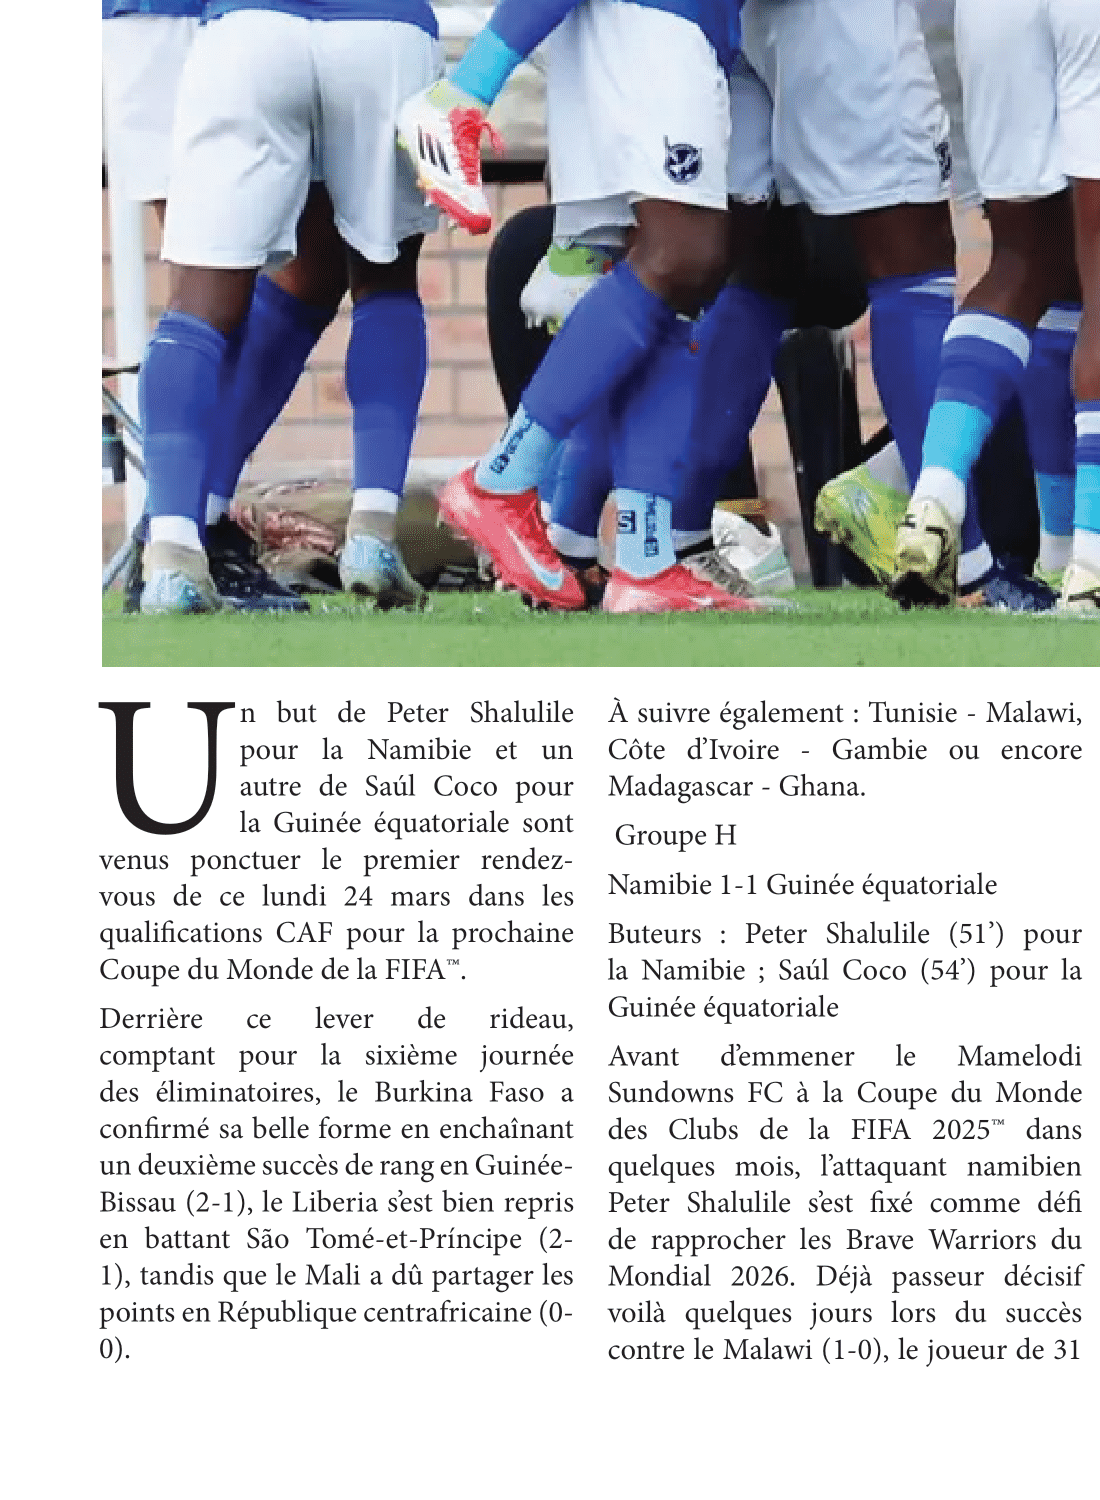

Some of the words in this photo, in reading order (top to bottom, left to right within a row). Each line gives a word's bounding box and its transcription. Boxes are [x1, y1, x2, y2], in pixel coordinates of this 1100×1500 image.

[276, 699, 317, 723] but
[337, 699, 366, 723] de
[387, 701, 449, 723] Peter
[470, 699, 574, 723] Shalulile
[239, 810, 262, 833] la
[273, 810, 362, 833] Guinée
[374, 809, 510, 840] équatoriale
[522, 814, 574, 833] sont
[615, 823, 707, 853] Groupe
[714, 824, 737, 846] H
[607, 871, 712, 895] Namibie
[721, 874, 757, 895] 1-1
[766, 872, 855, 895] Guinée
[862, 872, 998, 902] équatoriale
[99, 919, 263, 950] qualifications
[276, 921, 333, 943] CAF
[346, 927, 405, 950] pour
[417, 920, 440, 943] la
[451, 919, 574, 950] prochaine
[99, 1046, 216, 1073] comptant
[238, 1050, 298, 1073] pour
[320, 1042, 342, 1066] la
[365, 1043, 458, 1066] sixième
[479, 1043, 574, 1073] journée
[607, 1044, 680, 1067] Avant
[895, 1043, 916, 1067] le
[957, 1043, 1082, 1067] Mamelodi
[99, 1115, 210, 1139] confirmé
[219, 1123, 244, 1139] sa
[251, 1115, 310, 1139] belle
[318, 1115, 392, 1139] forme
[401, 1123, 430, 1139] en
[439, 1115, 574, 1139] enchaînant
[608, 1116, 648, 1140] des
[668, 1116, 739, 1140] Clubs
[759, 1116, 789, 1140] de
[808, 1117, 831, 1140] la
[851, 1118, 912, 1140] FIFA
[1026, 1116, 1082, 1140] dans
[608, 1191, 670, 1213] Peter
[687, 1189, 791, 1213] Shalulile
[869, 1189, 913, 1213] fixé
[930, 1197, 1021, 1213] comme
[1037, 1189, 1083, 1213] défi
[99, 1233, 129, 1249] en
[144, 1225, 231, 1249] battant
[246, 1227, 289, 1249] São
[305, 1226, 522, 1256] Tomé-et-Príncipe
[539, 1226, 573, 1254] (2-
